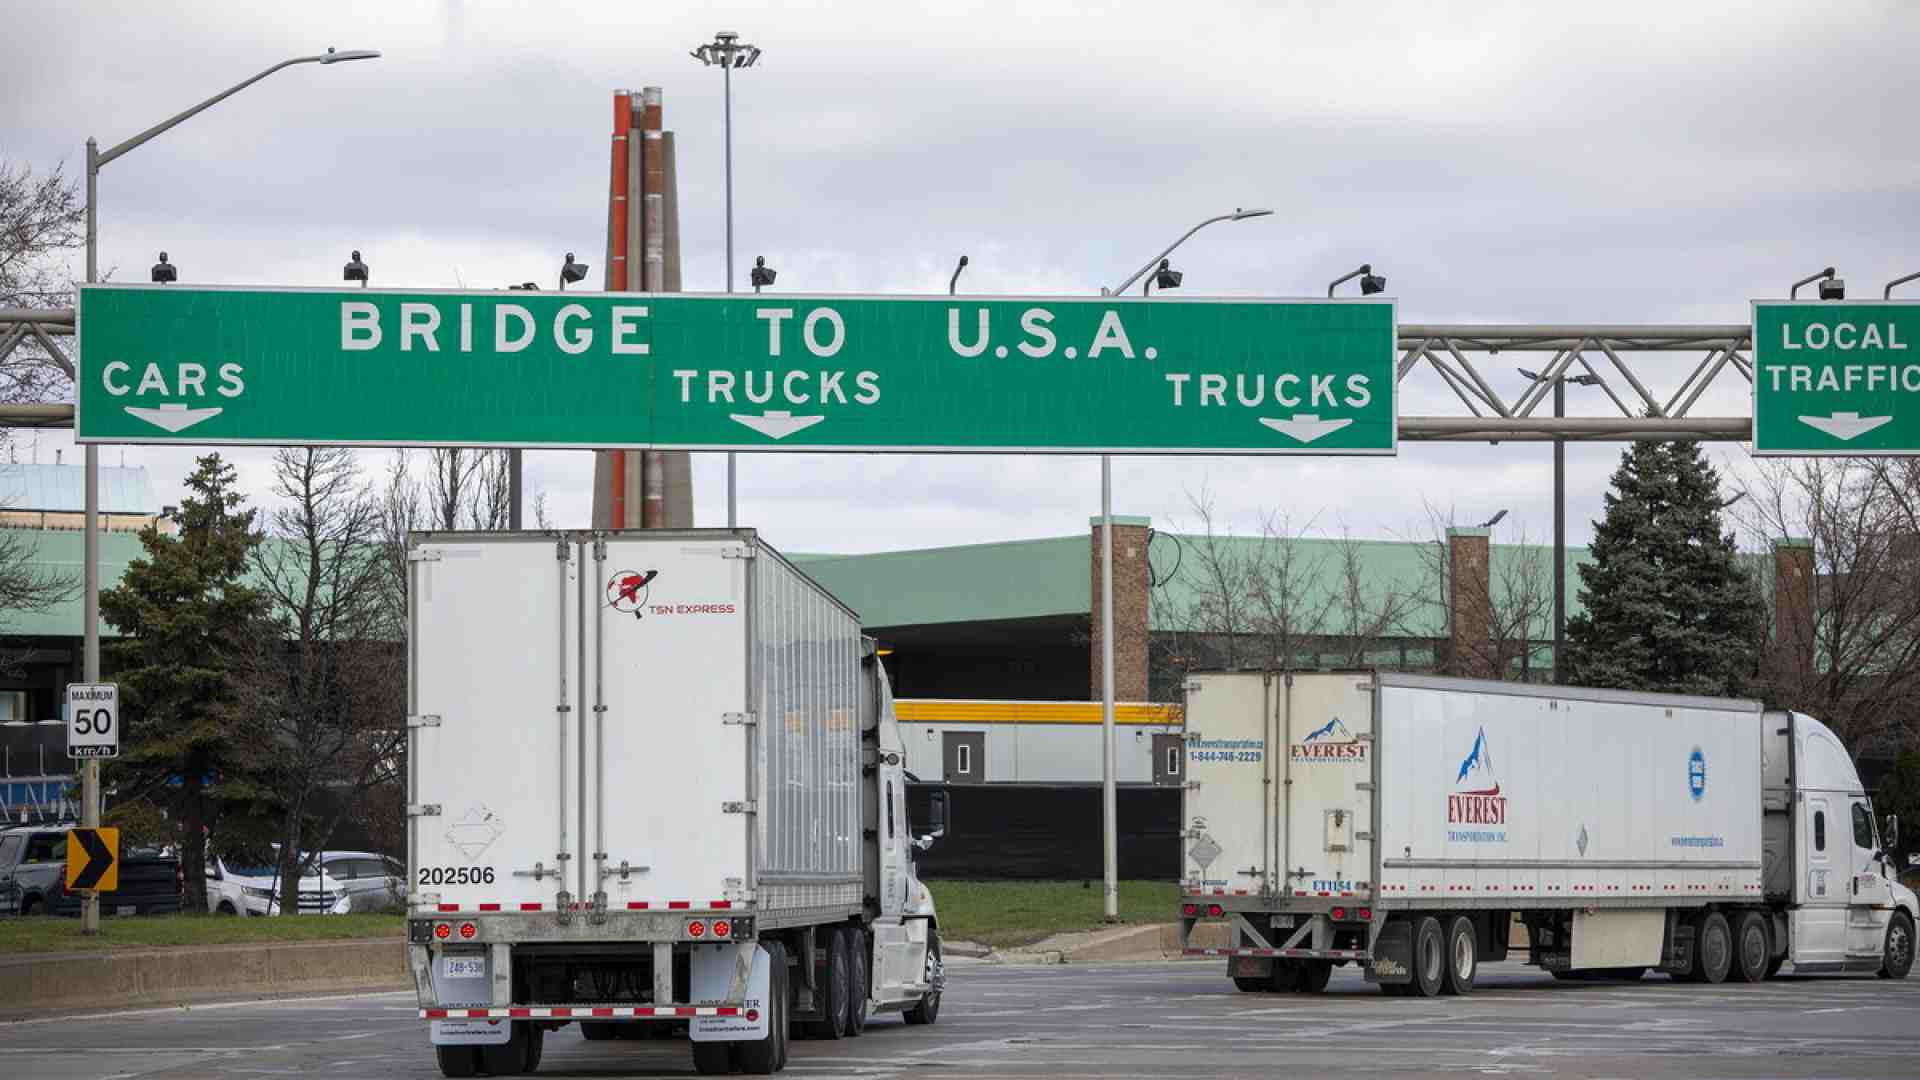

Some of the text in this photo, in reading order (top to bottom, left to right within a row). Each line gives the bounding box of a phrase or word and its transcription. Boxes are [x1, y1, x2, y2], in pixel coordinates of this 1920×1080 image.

[340, 301, 1158, 359] BRIDGE TO U.S.A.
[1783, 322, 1907, 350] LOCAL
[102, 361, 246, 398] CARS
[673, 369, 881, 405] TRUCKS
[1165, 373, 1371, 408] TRUCKS
[1766, 364, 1920, 392] TRAFFIC
[649, 604, 735, 614] TSN EXPRESS
[71, 690, 113, 700] MAXIMUM
[74, 708, 111, 735] 50
[74, 746, 111, 756] km/h
[1291, 744, 1368, 757] EVEREST
[1448, 795, 1507, 824] EVEREST
[418, 866, 495, 886] 202506
